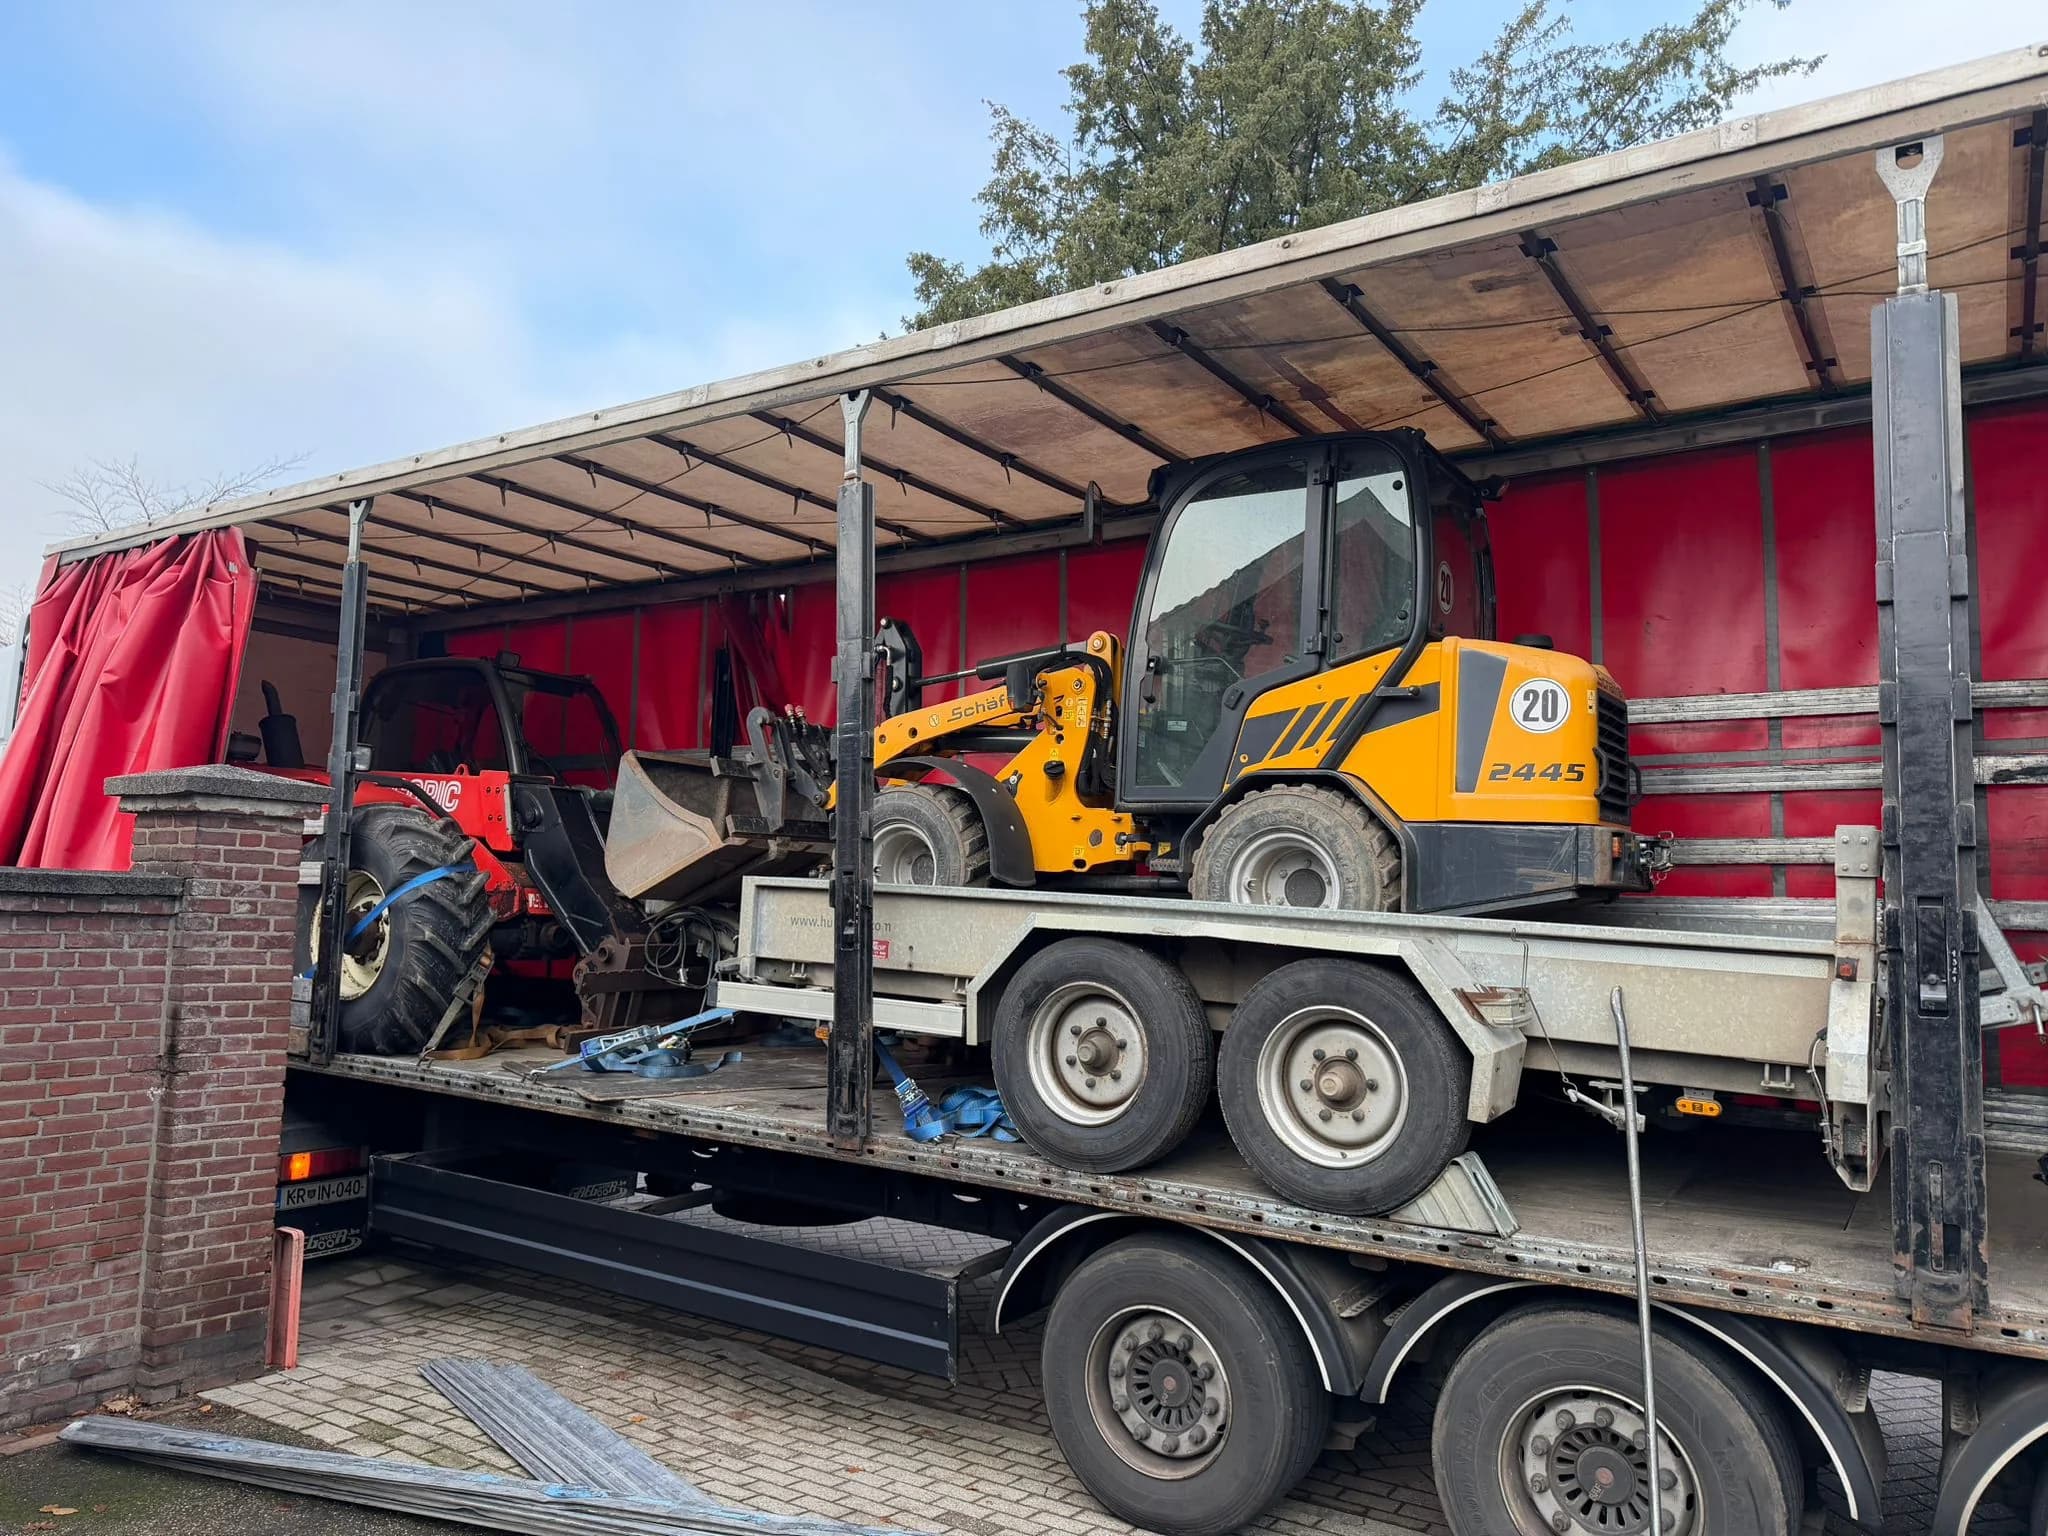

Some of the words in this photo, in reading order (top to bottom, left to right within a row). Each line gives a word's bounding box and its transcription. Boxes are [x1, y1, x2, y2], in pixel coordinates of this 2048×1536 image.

[1440, 570, 1451, 606] 20
[947, 693, 1006, 723] Schäf
[1522, 688, 1559, 723] 20
[1488, 762, 1586, 782] 2445
